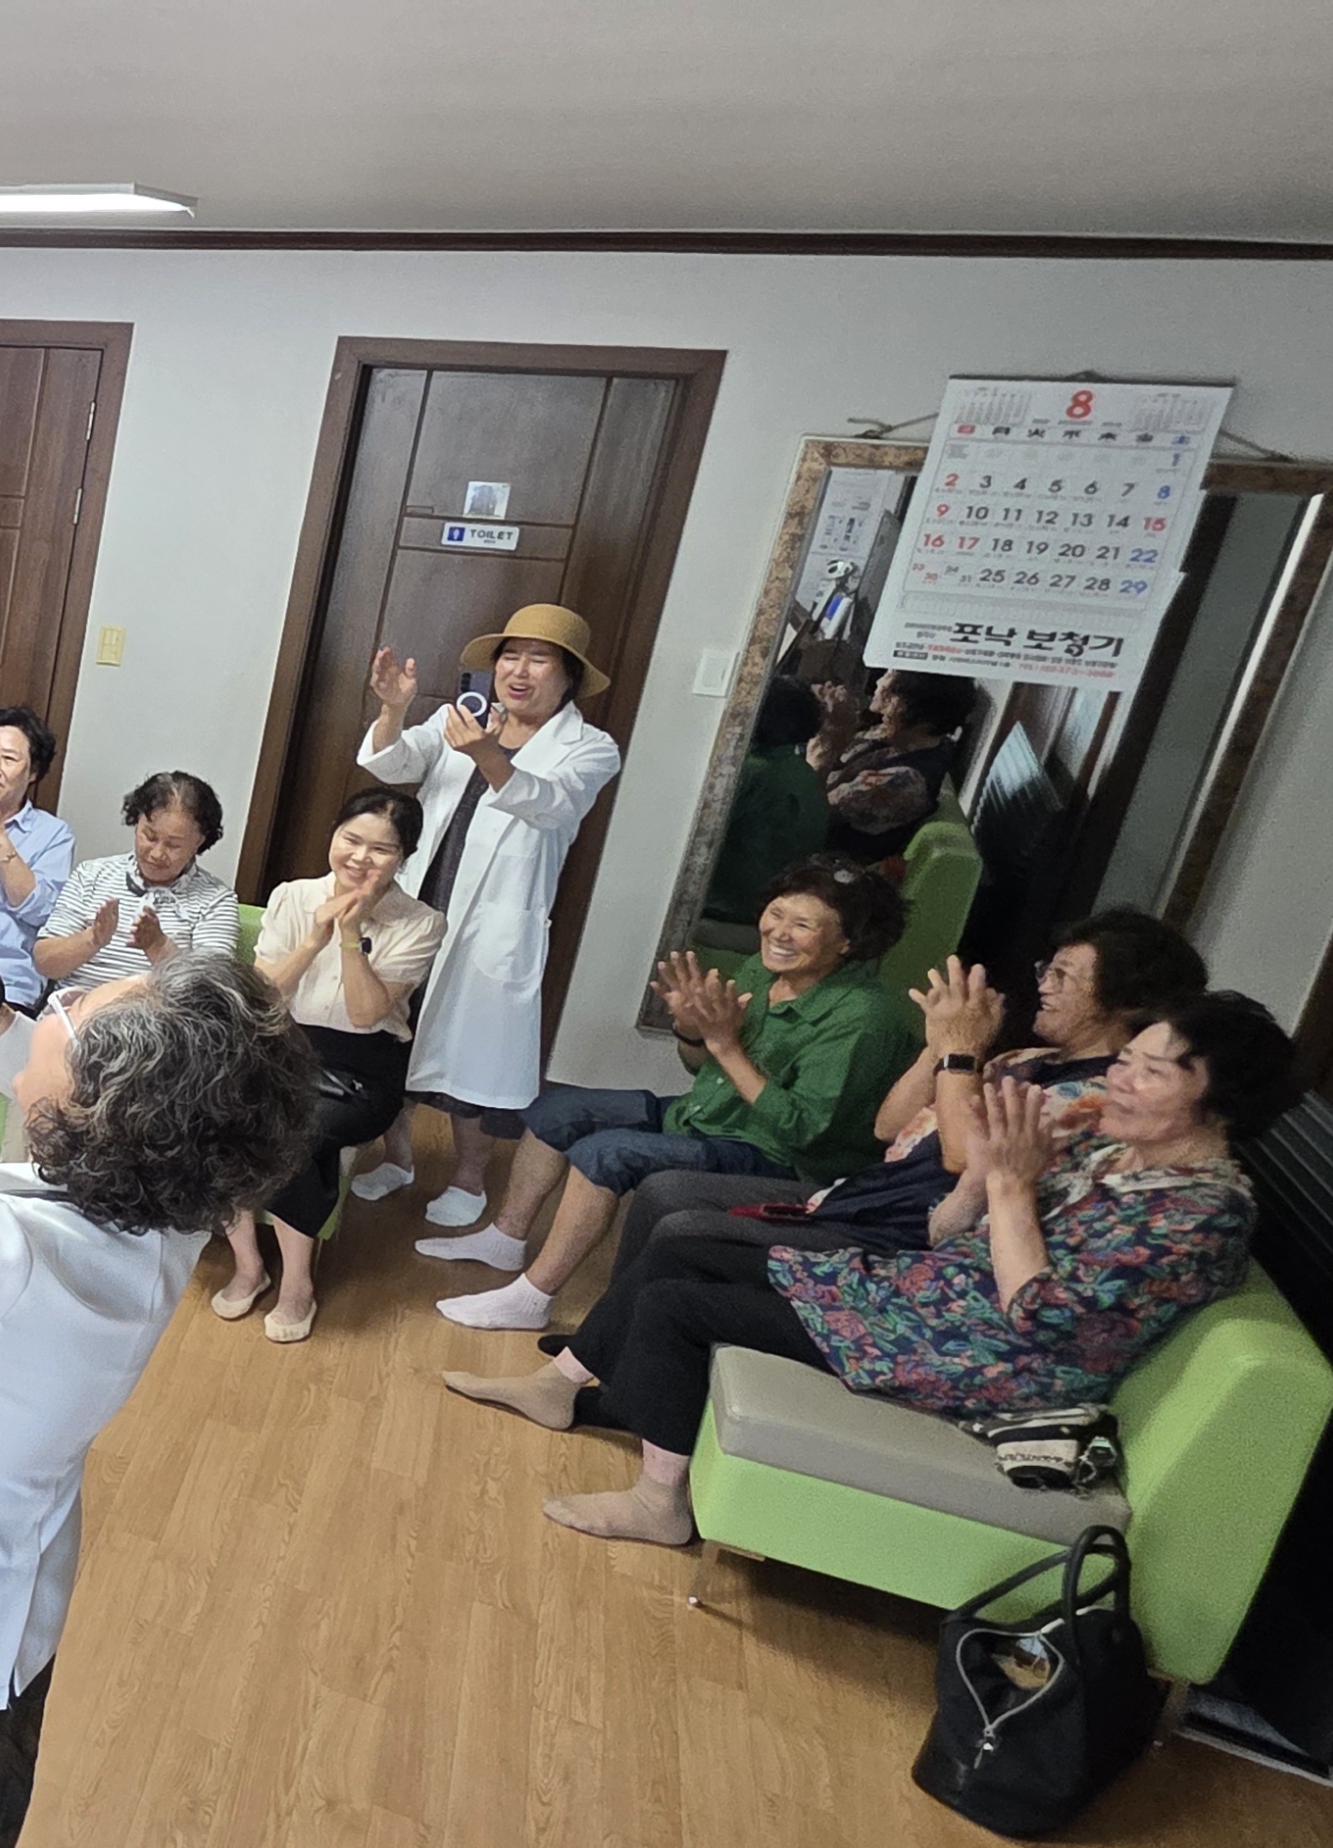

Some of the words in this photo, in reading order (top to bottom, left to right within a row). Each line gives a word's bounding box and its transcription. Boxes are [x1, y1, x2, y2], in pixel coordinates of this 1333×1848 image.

[1066, 390, 1094, 419] 8
[945, 474, 959, 486] 2
[979, 476, 992, 488] 3
[1014, 478, 1027, 490] 4
[1049, 480, 1063, 492] 5
[1085, 481, 1097, 494] 6
[1121, 483, 1135, 496] 7
[1157, 485, 1171, 498] 8
[937, 504, 949, 516] 9
[965, 506, 989, 520] 10
[1002, 508, 1023, 522] 11
[1035, 510, 1059, 524] 12
[1071, 512, 1093, 527] 13
[1106, 514, 1131, 528] 14
[1143, 517, 1166, 532] 15
[470, 529, 513, 540] TOILET
[923, 534, 944, 548] 16
[957, 536, 980, 550] 17
[991, 538, 1013, 552] 18
[1025, 541, 1049, 554] 19
[1057, 544, 1085, 558] 20
[1095, 546, 1121, 560] 21
[1129, 548, 1159, 563] 22
[979, 568, 1006, 583] 25
[1013, 571, 1041, 585] 26
[1049, 574, 1075, 588] 27
[1084, 577, 1111, 592] 28
[1119, 580, 1147, 594] 29
[950, 622, 1017, 646] 포낙
[1023, 630, 1123, 658] 보청기
